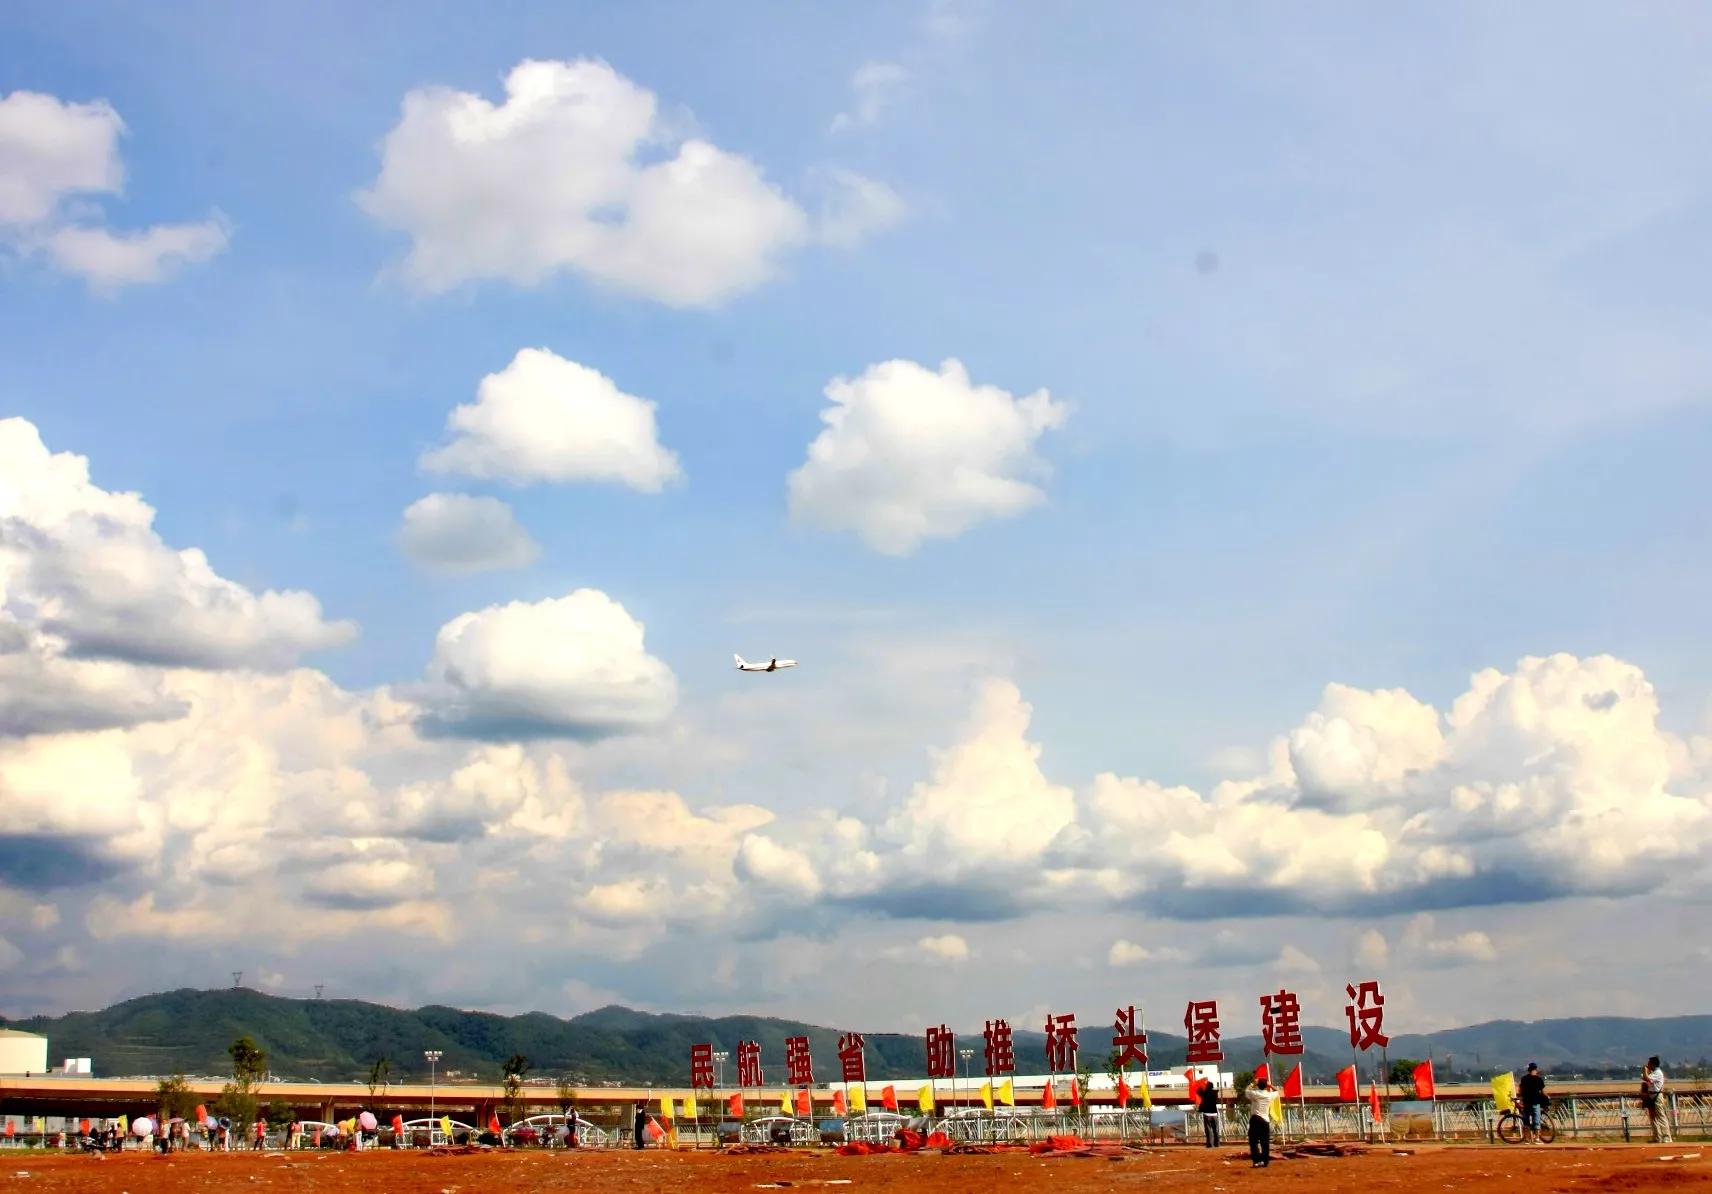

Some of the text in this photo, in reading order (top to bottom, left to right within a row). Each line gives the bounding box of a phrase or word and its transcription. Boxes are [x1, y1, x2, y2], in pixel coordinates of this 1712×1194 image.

[691, 981, 1389, 1088] 民航强省 助推桥头堡建设
